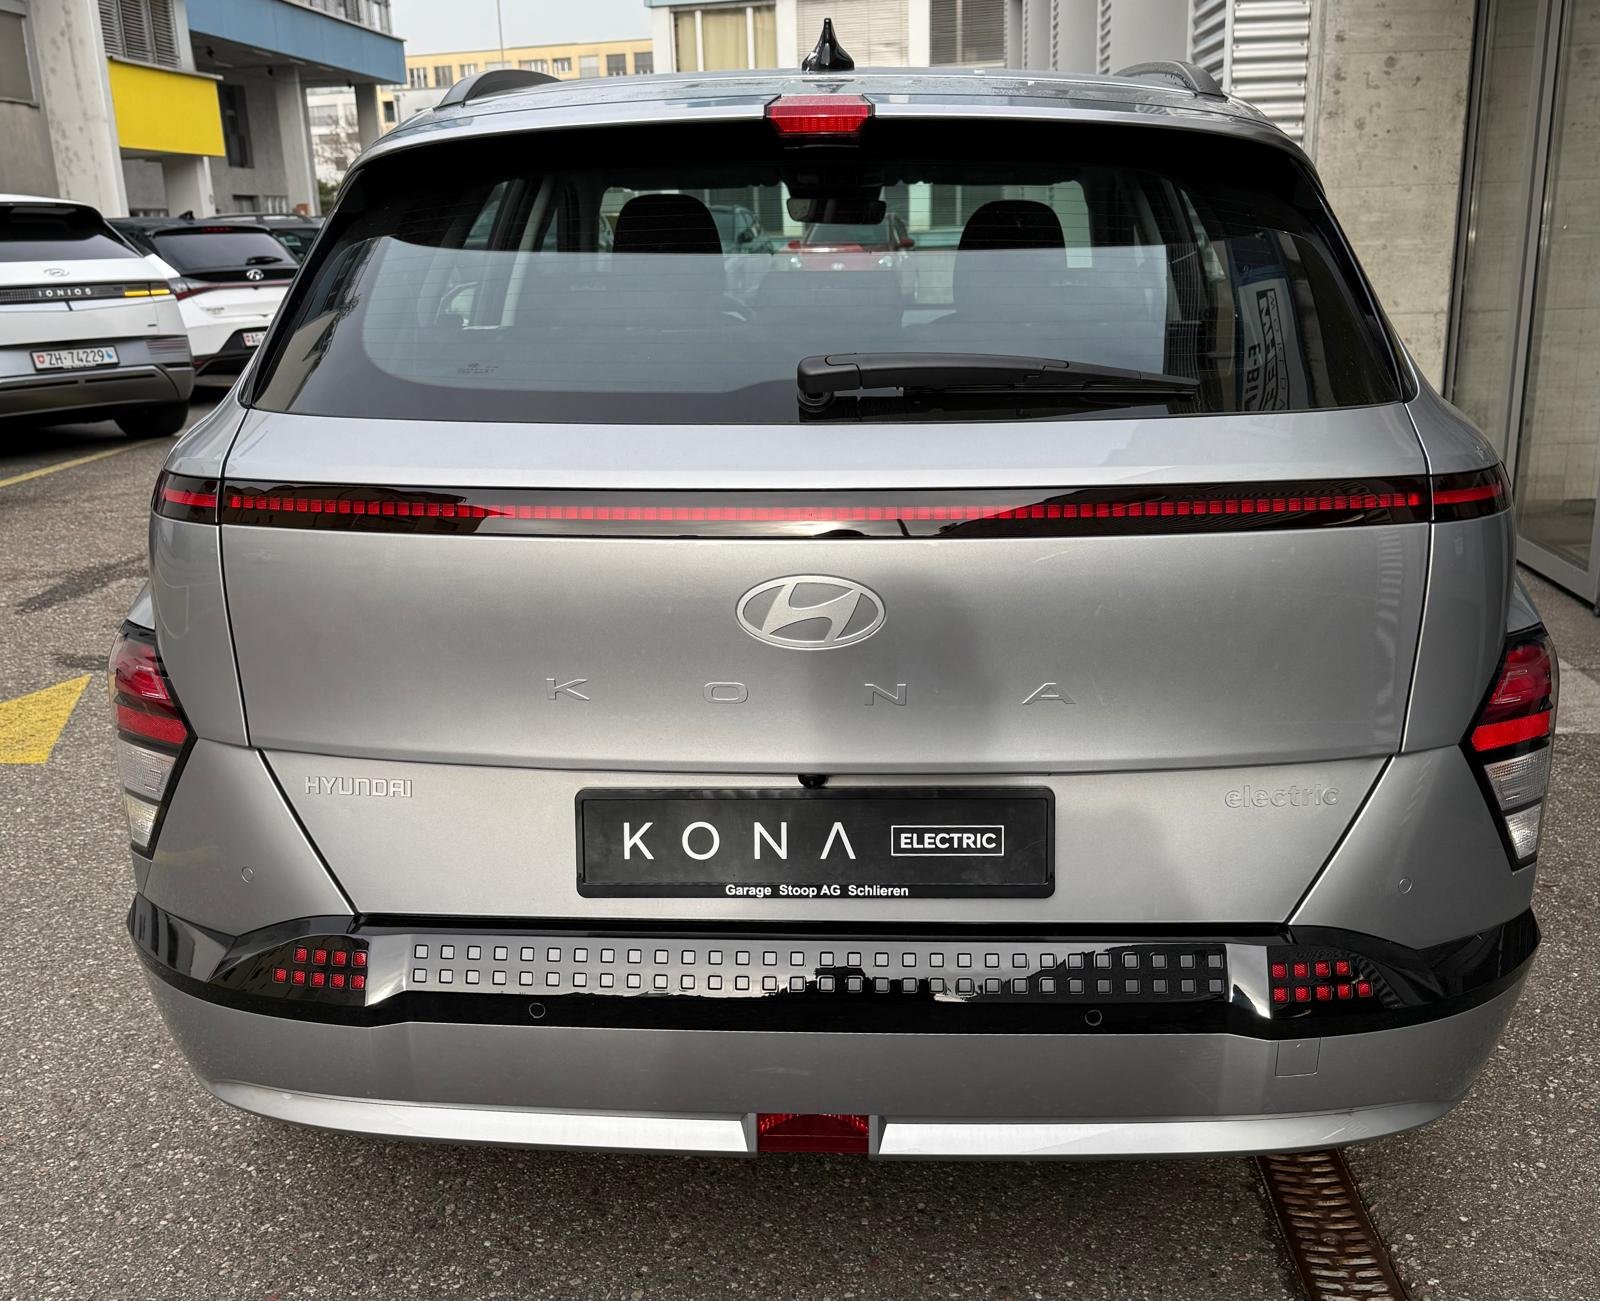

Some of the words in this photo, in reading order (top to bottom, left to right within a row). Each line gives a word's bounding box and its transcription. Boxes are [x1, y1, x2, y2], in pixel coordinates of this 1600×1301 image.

[305, 776, 412, 798] HYUNDAI
[1224, 784, 1340, 808] electric
[623, 821, 857, 861] KONA
[900, 833, 997, 849] ELECTRIC
[725, 884, 772, 898] Garage
[779, 884, 818, 898] Stoop
[820, 884, 841, 896] AG
[848, 884, 909, 897] Schlieren
